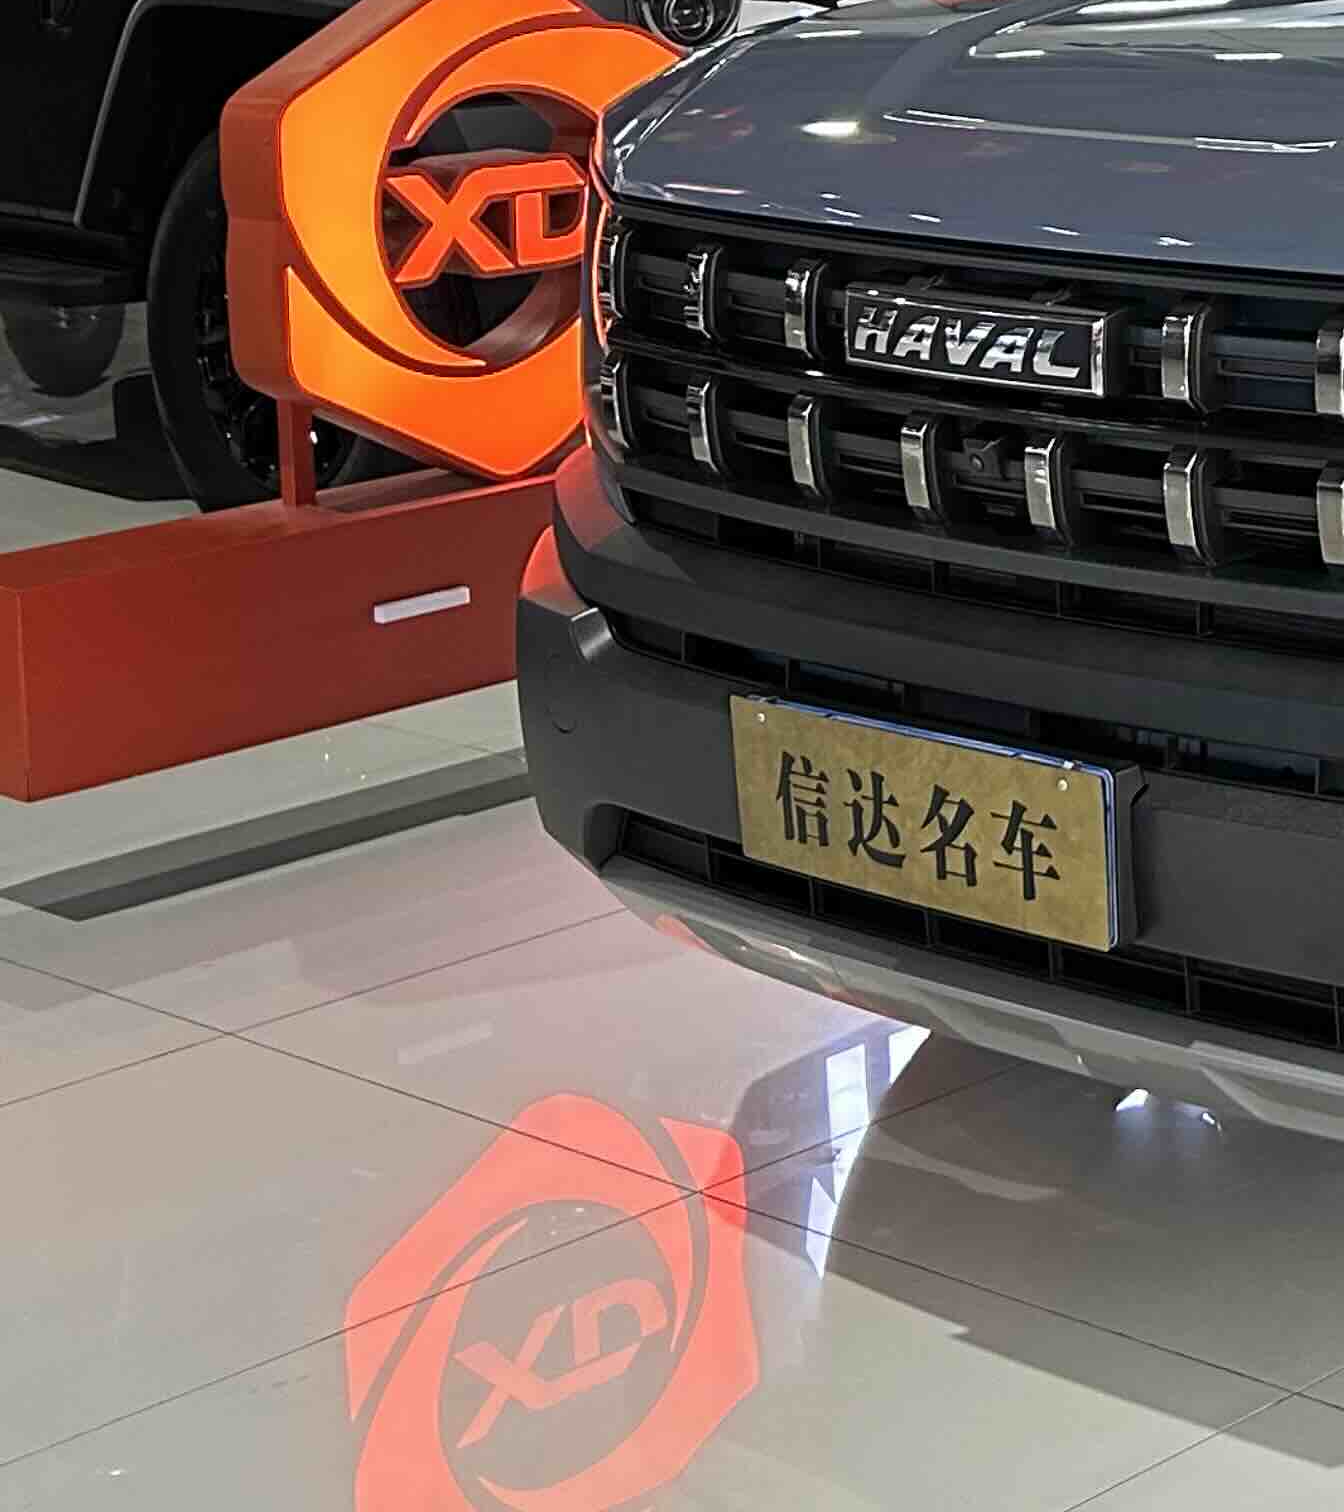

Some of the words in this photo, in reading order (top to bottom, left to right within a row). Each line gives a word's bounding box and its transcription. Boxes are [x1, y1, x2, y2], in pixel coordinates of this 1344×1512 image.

[853, 305, 1081, 380] HAVAL
[774, 750, 1061, 901] 信达名车
